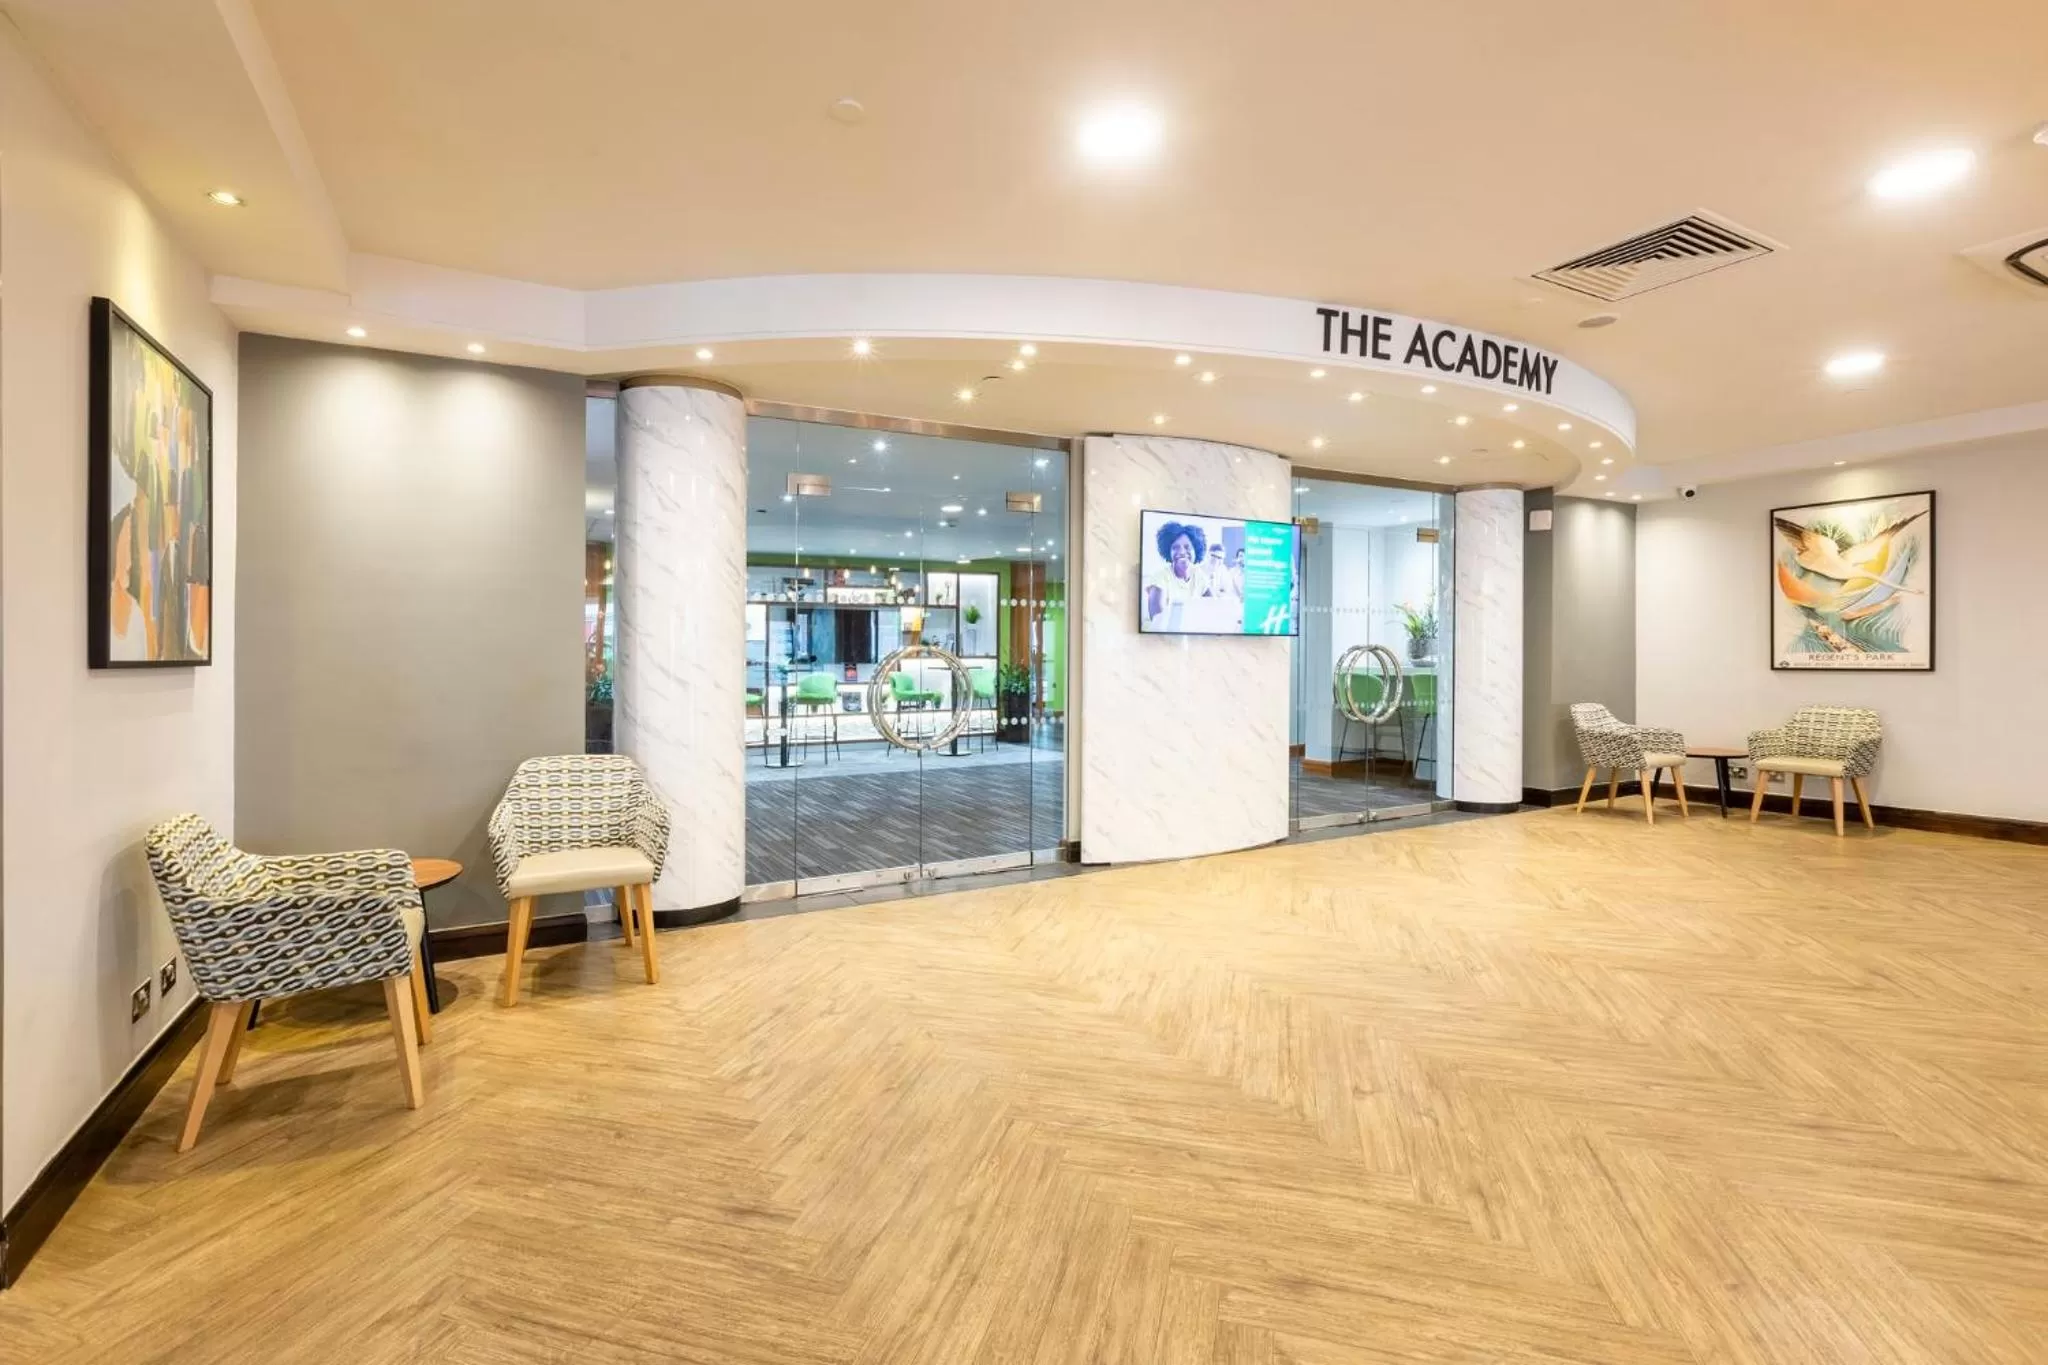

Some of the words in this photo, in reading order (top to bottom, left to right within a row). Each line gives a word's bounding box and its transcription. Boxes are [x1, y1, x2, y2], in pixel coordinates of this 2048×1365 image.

[1316, 308, 1392, 360] THE
[1403, 323, 1558, 394] ACADEMY
[1865, 652, 1894, 661] PARK
